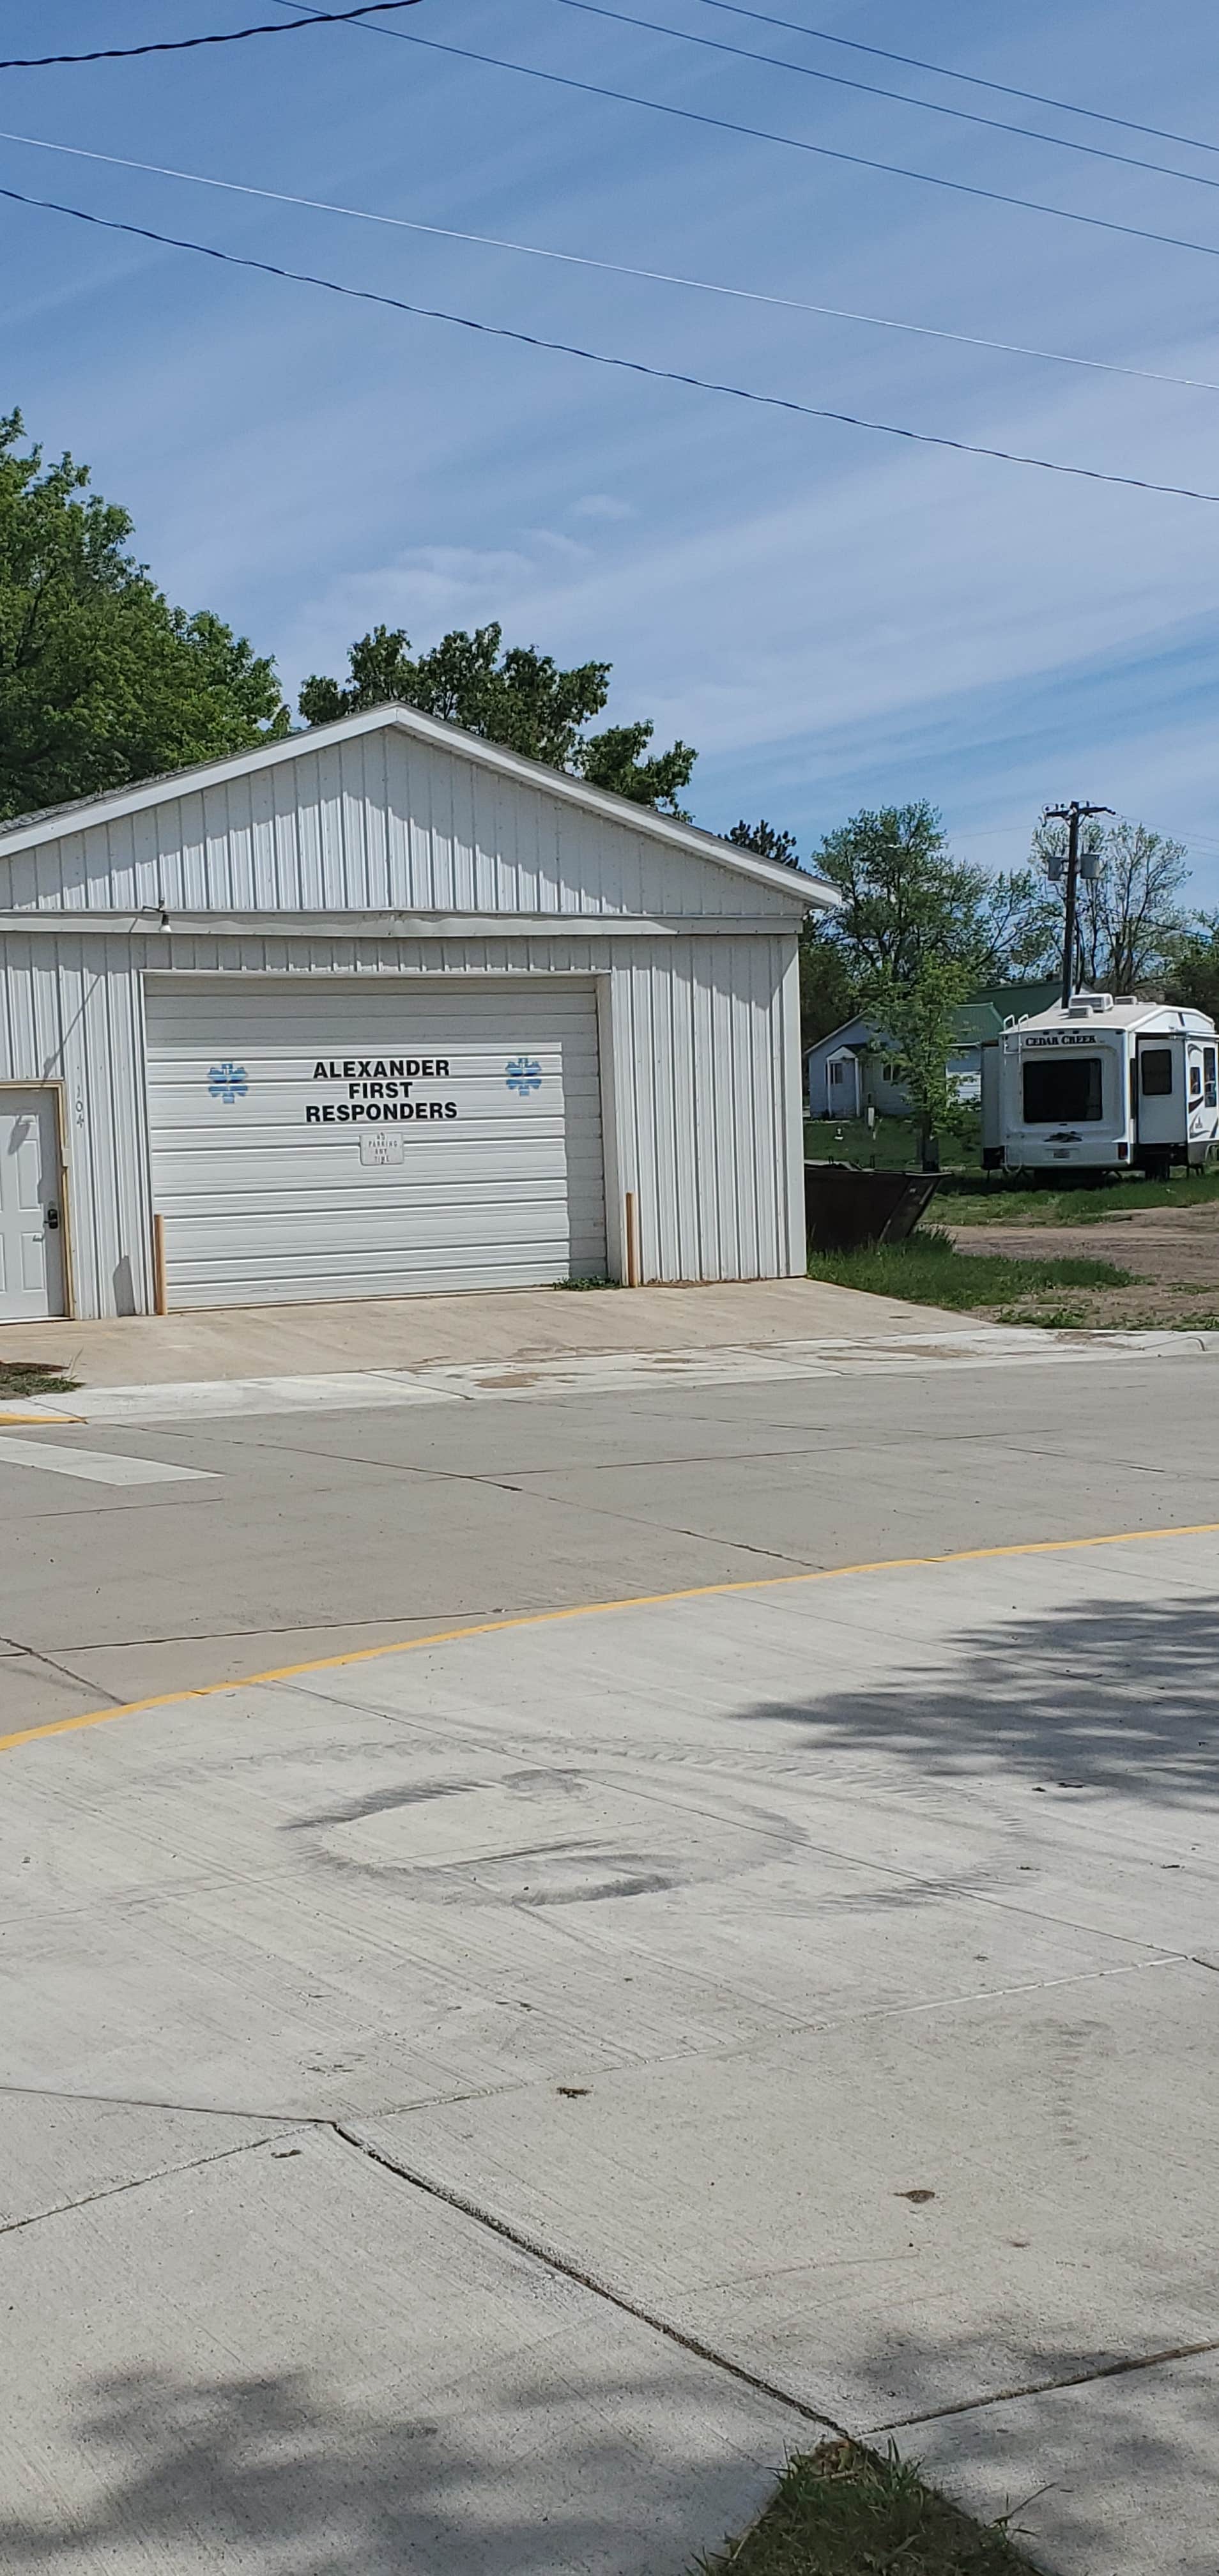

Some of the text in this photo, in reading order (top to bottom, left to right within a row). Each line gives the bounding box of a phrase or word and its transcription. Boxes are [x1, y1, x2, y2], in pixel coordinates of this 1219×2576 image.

[1025, 1035, 1096, 1046] CEDAR CREEK
[312, 1059, 450, 1078] ALEXANDER
[348, 1081, 413, 1100] FIRST
[75, 1084, 84, 1129] 104
[305, 1101, 458, 1123] RESPONDERS
